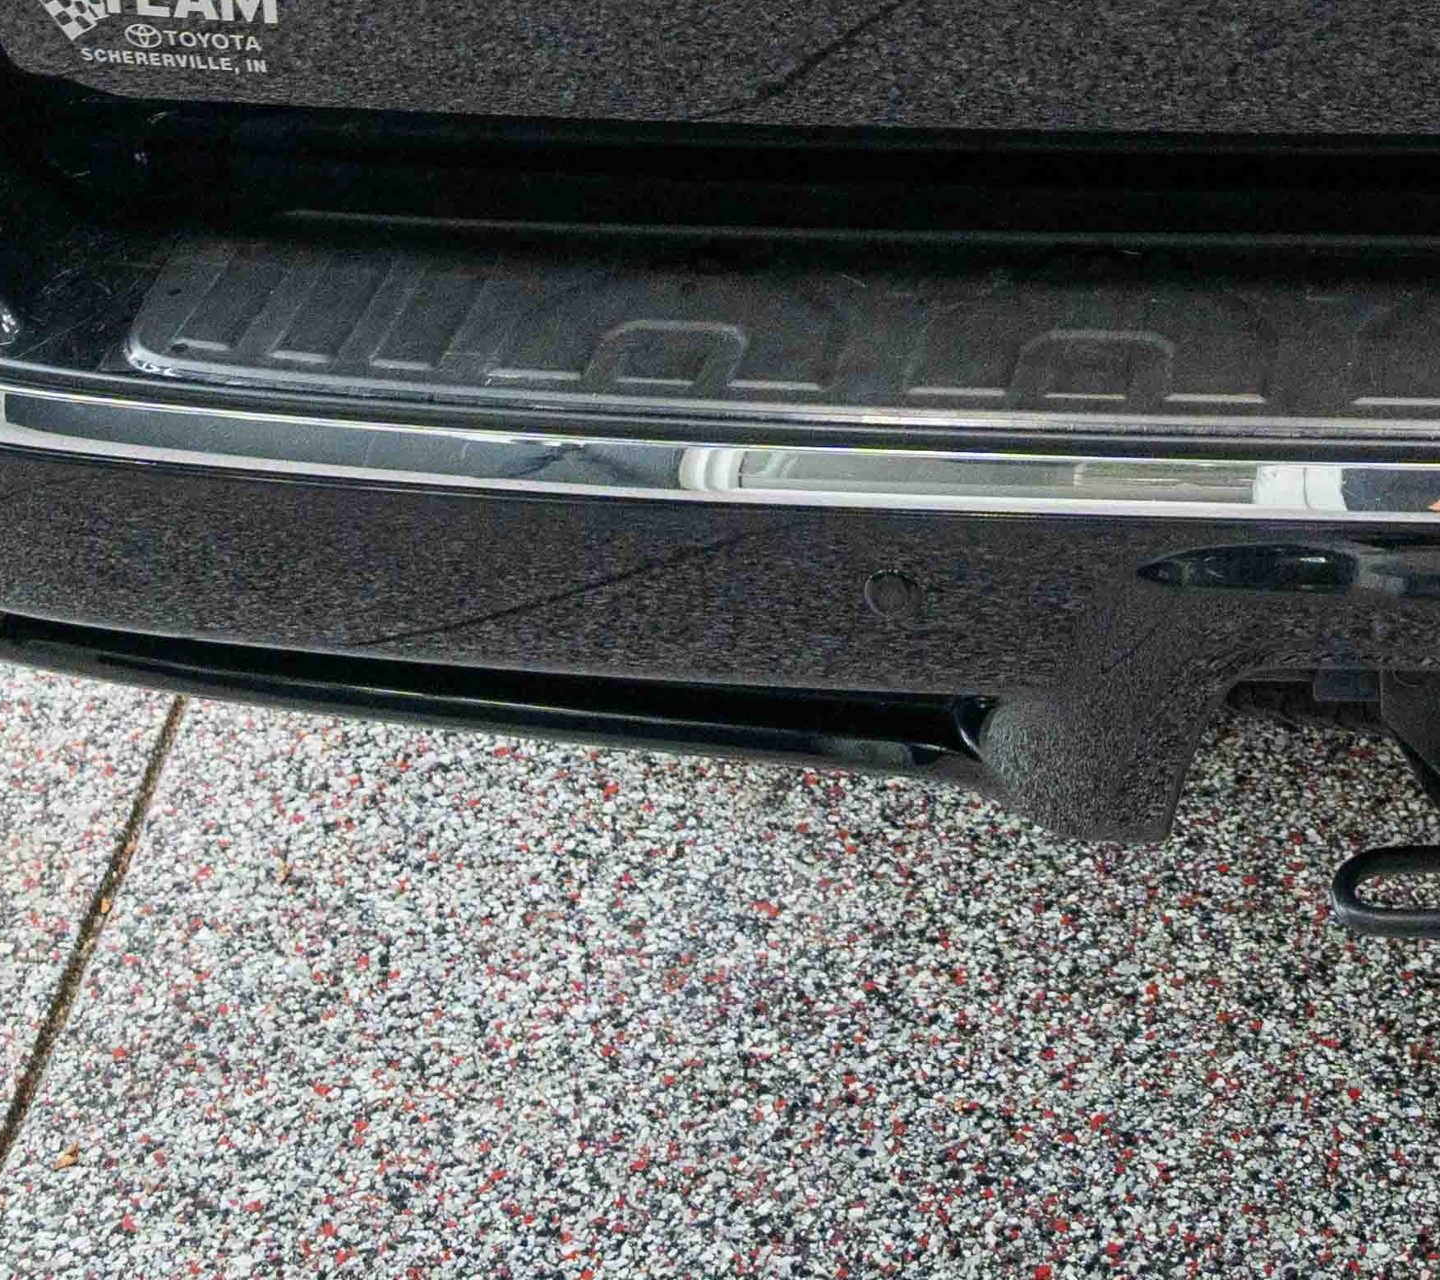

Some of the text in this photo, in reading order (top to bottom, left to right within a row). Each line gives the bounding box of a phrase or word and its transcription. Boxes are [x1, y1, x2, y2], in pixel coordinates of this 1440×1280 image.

[162, 30, 262, 52] TOYOTA
[80, 48, 268, 75] SCHERERVILLE, IN
